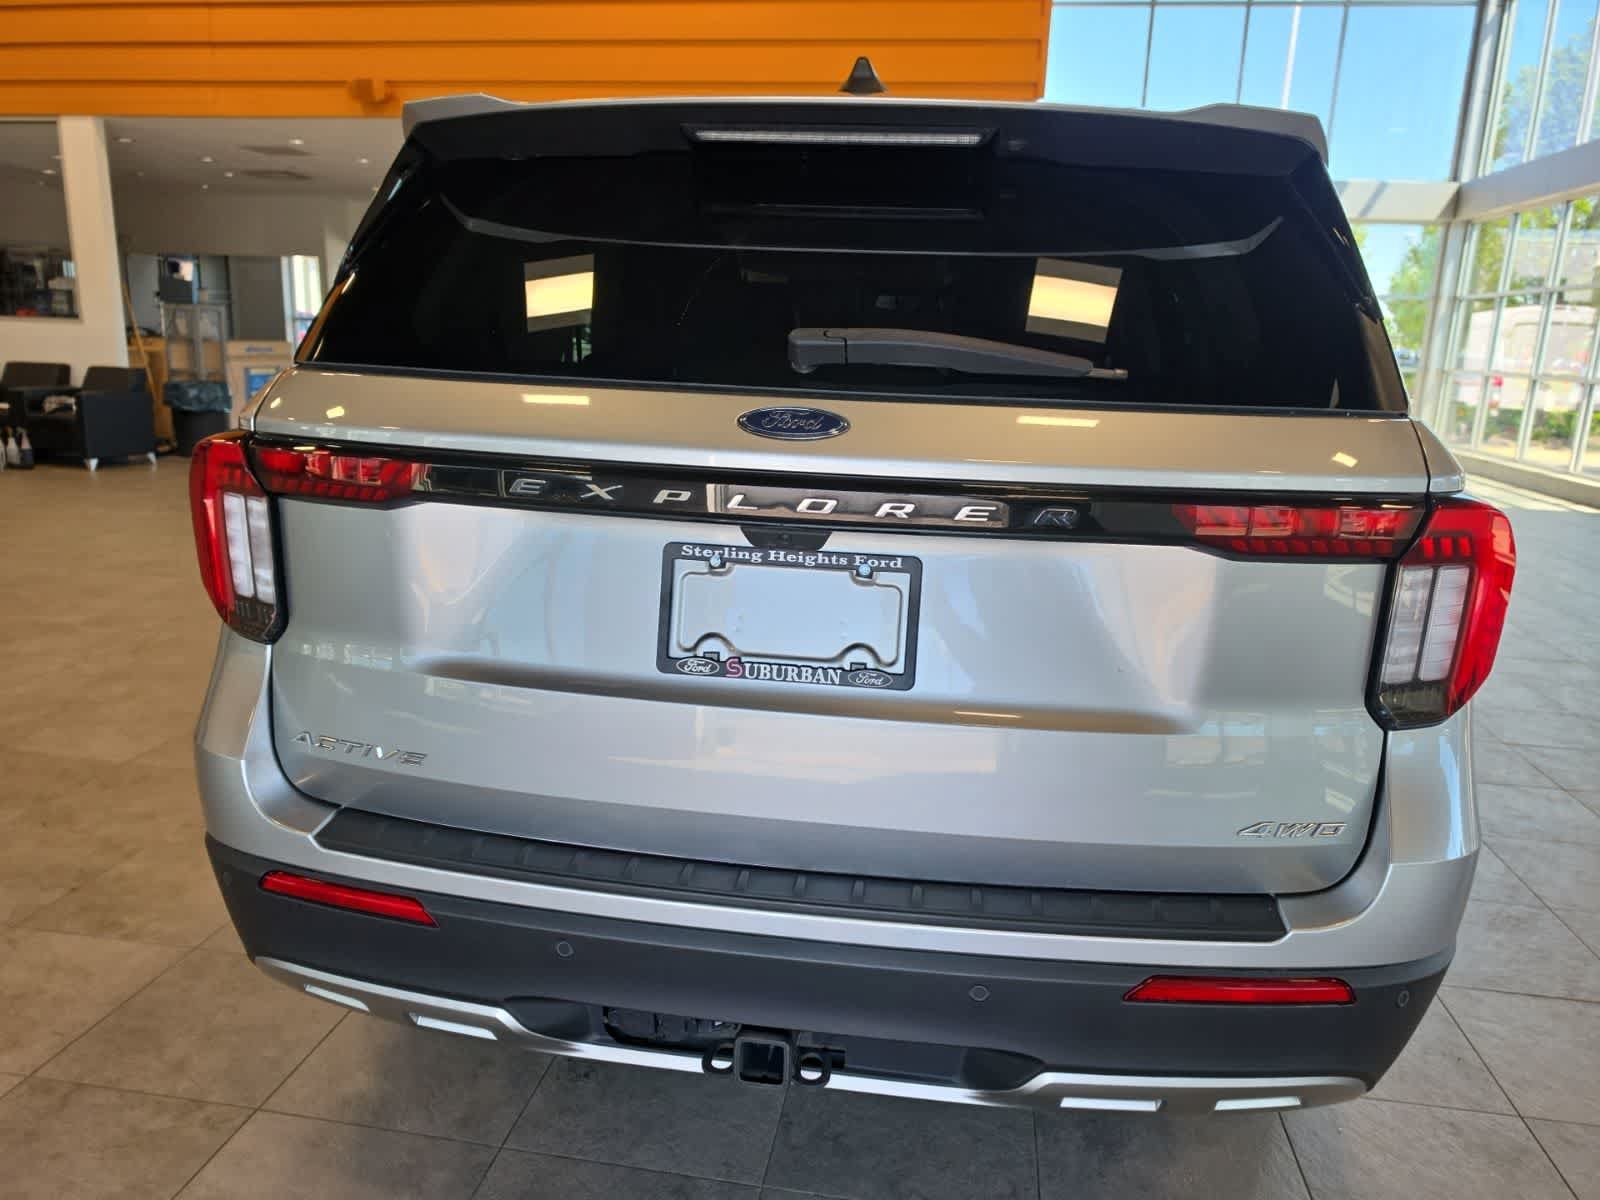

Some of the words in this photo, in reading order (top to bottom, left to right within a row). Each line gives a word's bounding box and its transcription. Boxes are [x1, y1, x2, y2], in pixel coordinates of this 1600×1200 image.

[762, 412, 824, 430] Ford
[509, 478, 1078, 529] EXPLORER
[681, 544, 763, 563] Sterling
[768, 550, 848, 567] Heights
[853, 555, 903, 569] Ford
[684, 659, 712, 673] Ford
[726, 658, 842, 685] SUBURBAN
[855, 672, 885, 686] Ford
[291, 731, 427, 766] ACTIVE
[1237, 821, 1345, 837] 4WD
